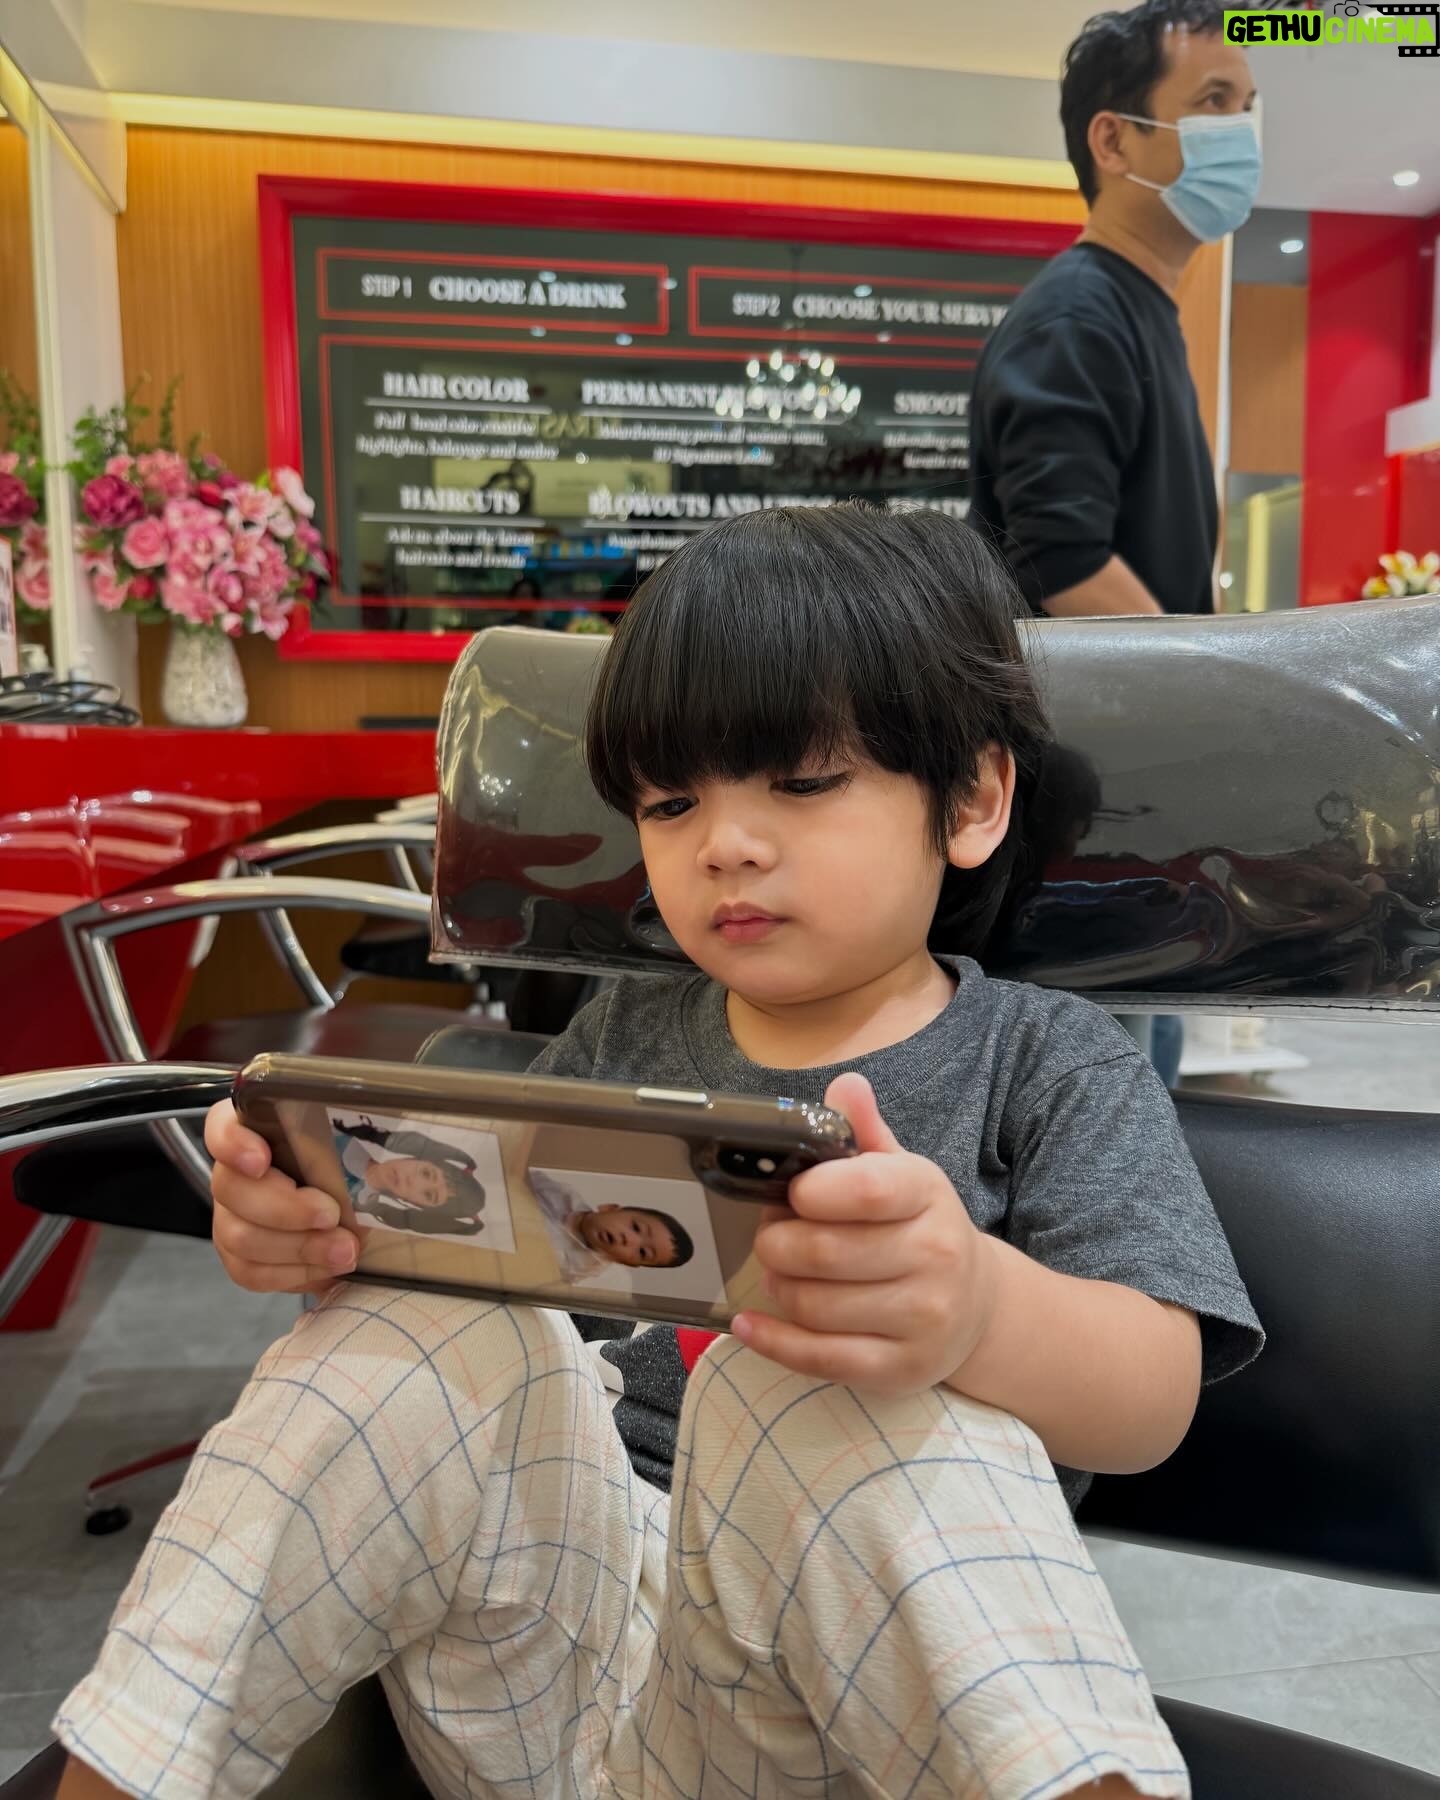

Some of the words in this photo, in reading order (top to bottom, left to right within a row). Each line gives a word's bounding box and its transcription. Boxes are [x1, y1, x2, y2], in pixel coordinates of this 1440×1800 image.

[361, 273, 400, 297] STEP
[402, 276, 412, 298] 1
[428, 275, 527, 304] CHOOSE
[528, 280, 547, 306] A
[548, 281, 627, 309] DRINK
[732, 292, 769, 317] STEP
[769, 294, 781, 318] 2
[792, 295, 880, 320] CHOOSE
[881, 298, 940, 324] YOUR
[384, 371, 447, 399] HAIR
[447, 375, 530, 403] COLOR
[581, 380, 719, 409] PERMANENT
[400, 485, 521, 515] HAIRCUTS
[587, 491, 711, 518] BLOWOUTS
